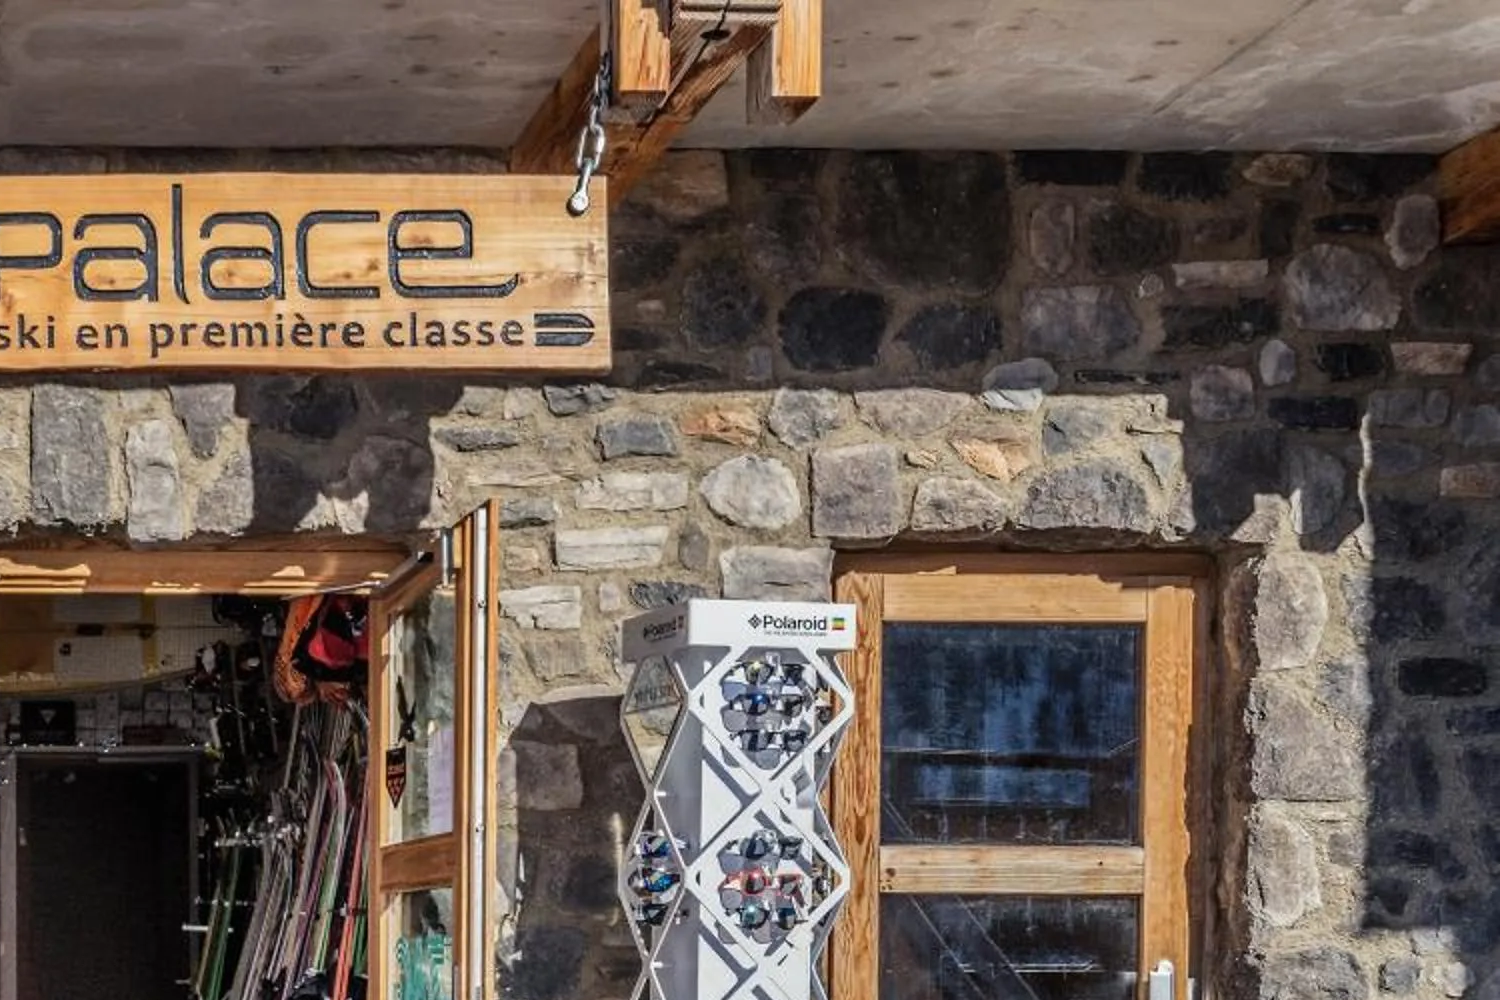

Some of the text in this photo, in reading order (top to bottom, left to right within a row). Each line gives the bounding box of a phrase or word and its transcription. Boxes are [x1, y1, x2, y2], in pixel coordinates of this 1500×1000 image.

[75, 322, 130, 349] en
[149, 312, 366, 358] première
[382, 311, 525, 348] classe
[762, 615, 828, 631] Polaroid
